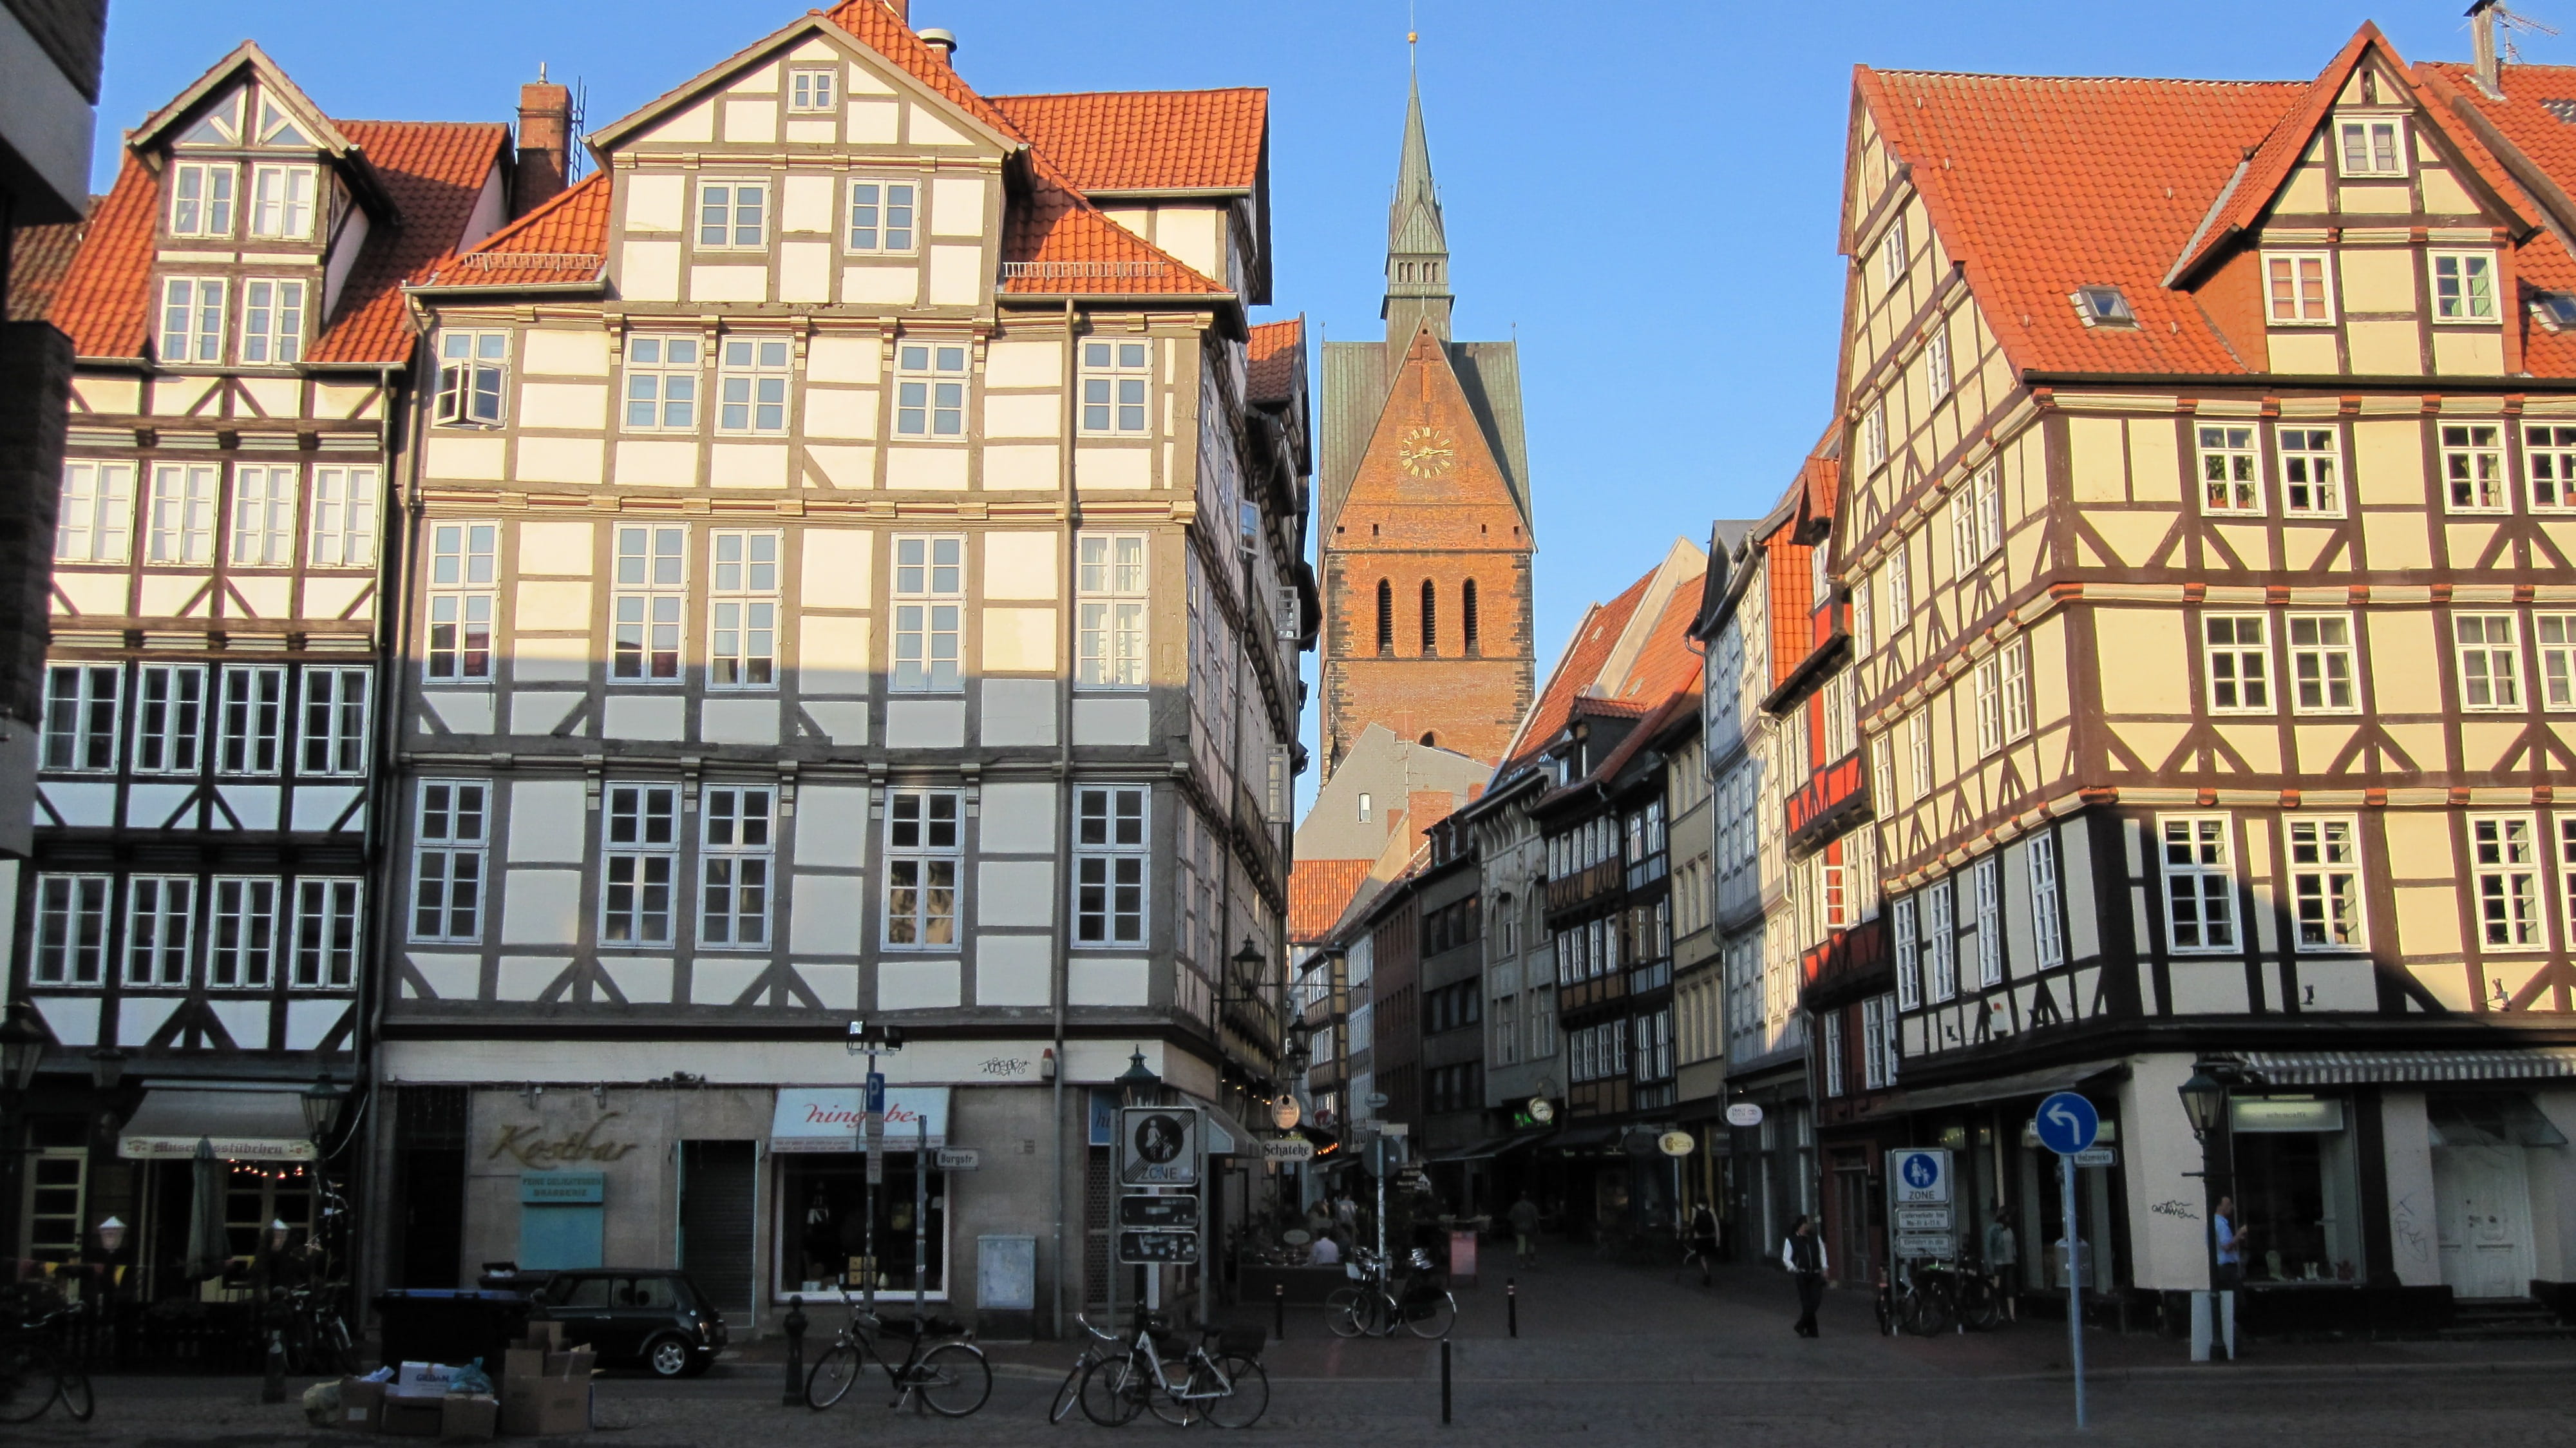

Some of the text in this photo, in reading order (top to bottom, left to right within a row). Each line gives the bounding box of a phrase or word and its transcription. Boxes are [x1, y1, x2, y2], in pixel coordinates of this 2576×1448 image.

[869, 1077, 880, 1107] P
[804, 1103, 919, 1129] hingbe.
[488, 1110, 638, 1170] Kostbar
[1264, 1143, 1310, 1157] Schateke
[1909, 1190, 1935, 1199] ZONE
